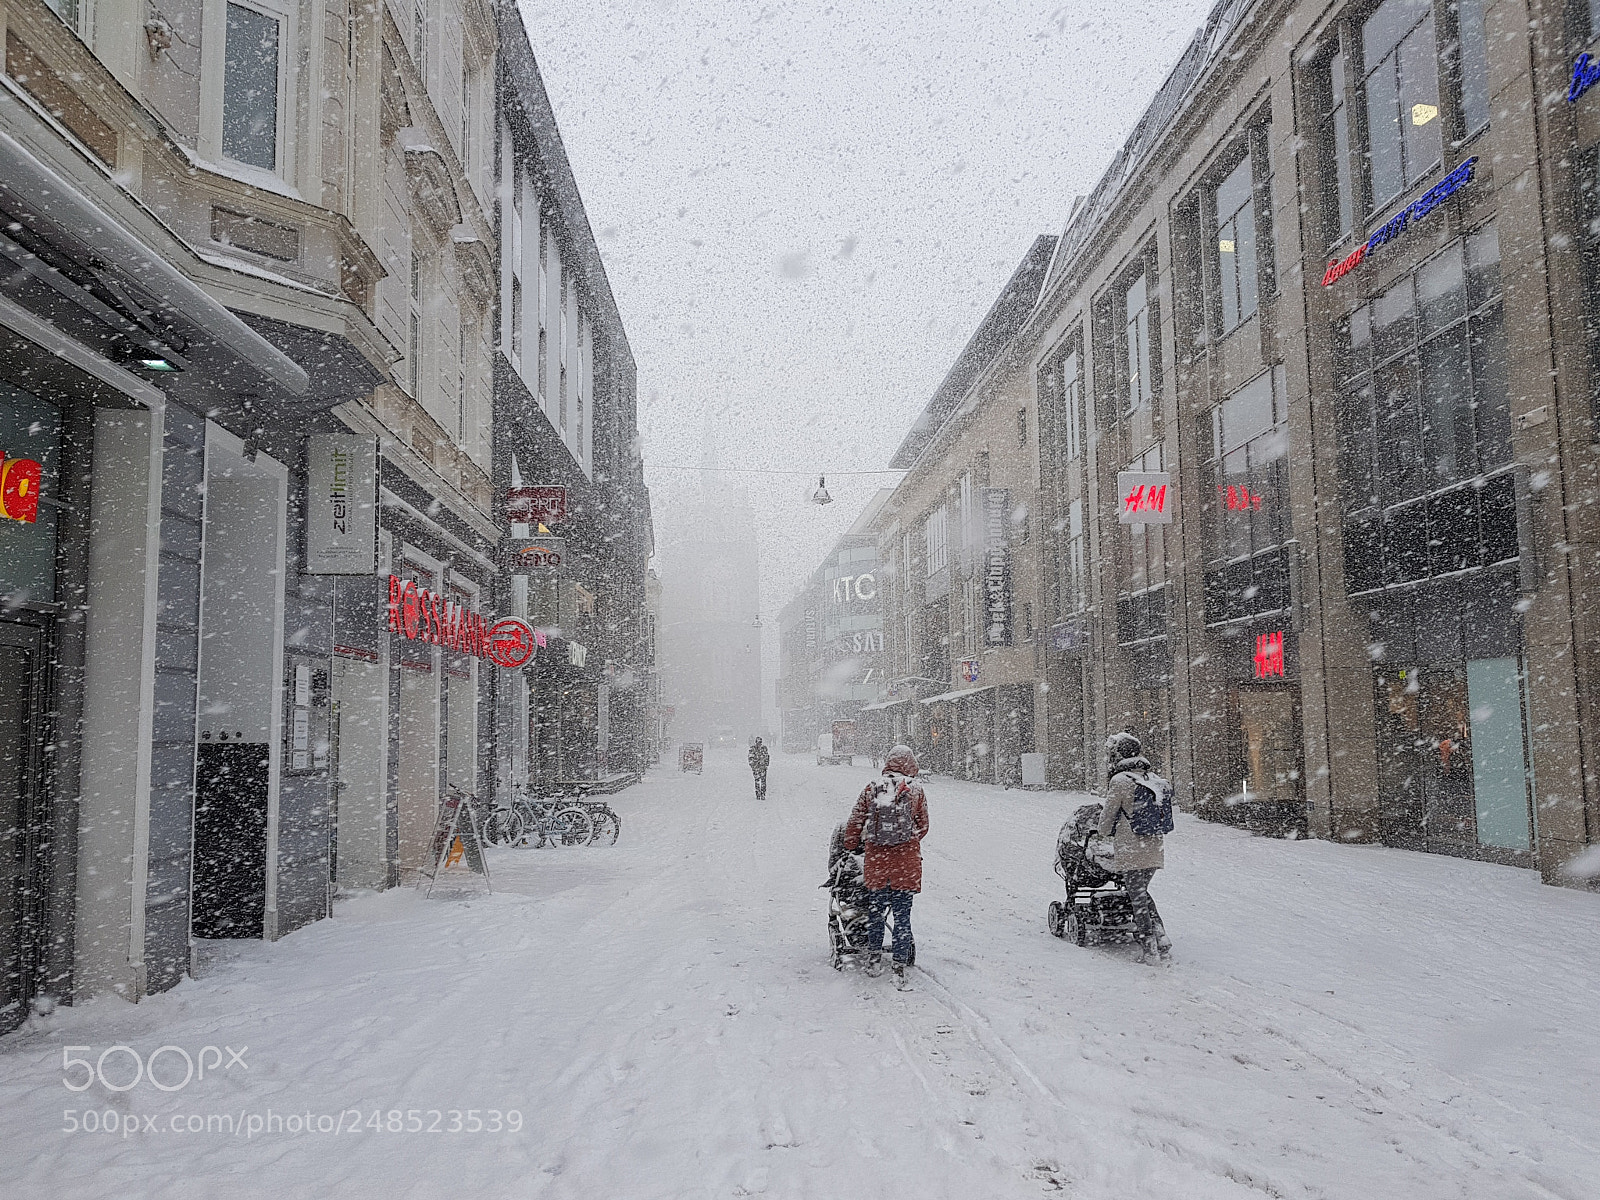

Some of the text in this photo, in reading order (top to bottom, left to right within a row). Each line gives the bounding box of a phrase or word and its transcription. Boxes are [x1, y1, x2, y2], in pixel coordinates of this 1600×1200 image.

[330, 447, 346, 534] zeitlimit
[1124, 484, 1167, 513] H&M
[511, 553, 561, 567] RENO
[833, 573, 876, 602] KTC
[389, 574, 488, 660] ROSSMANN
[1254, 630, 1284, 679] H&M
